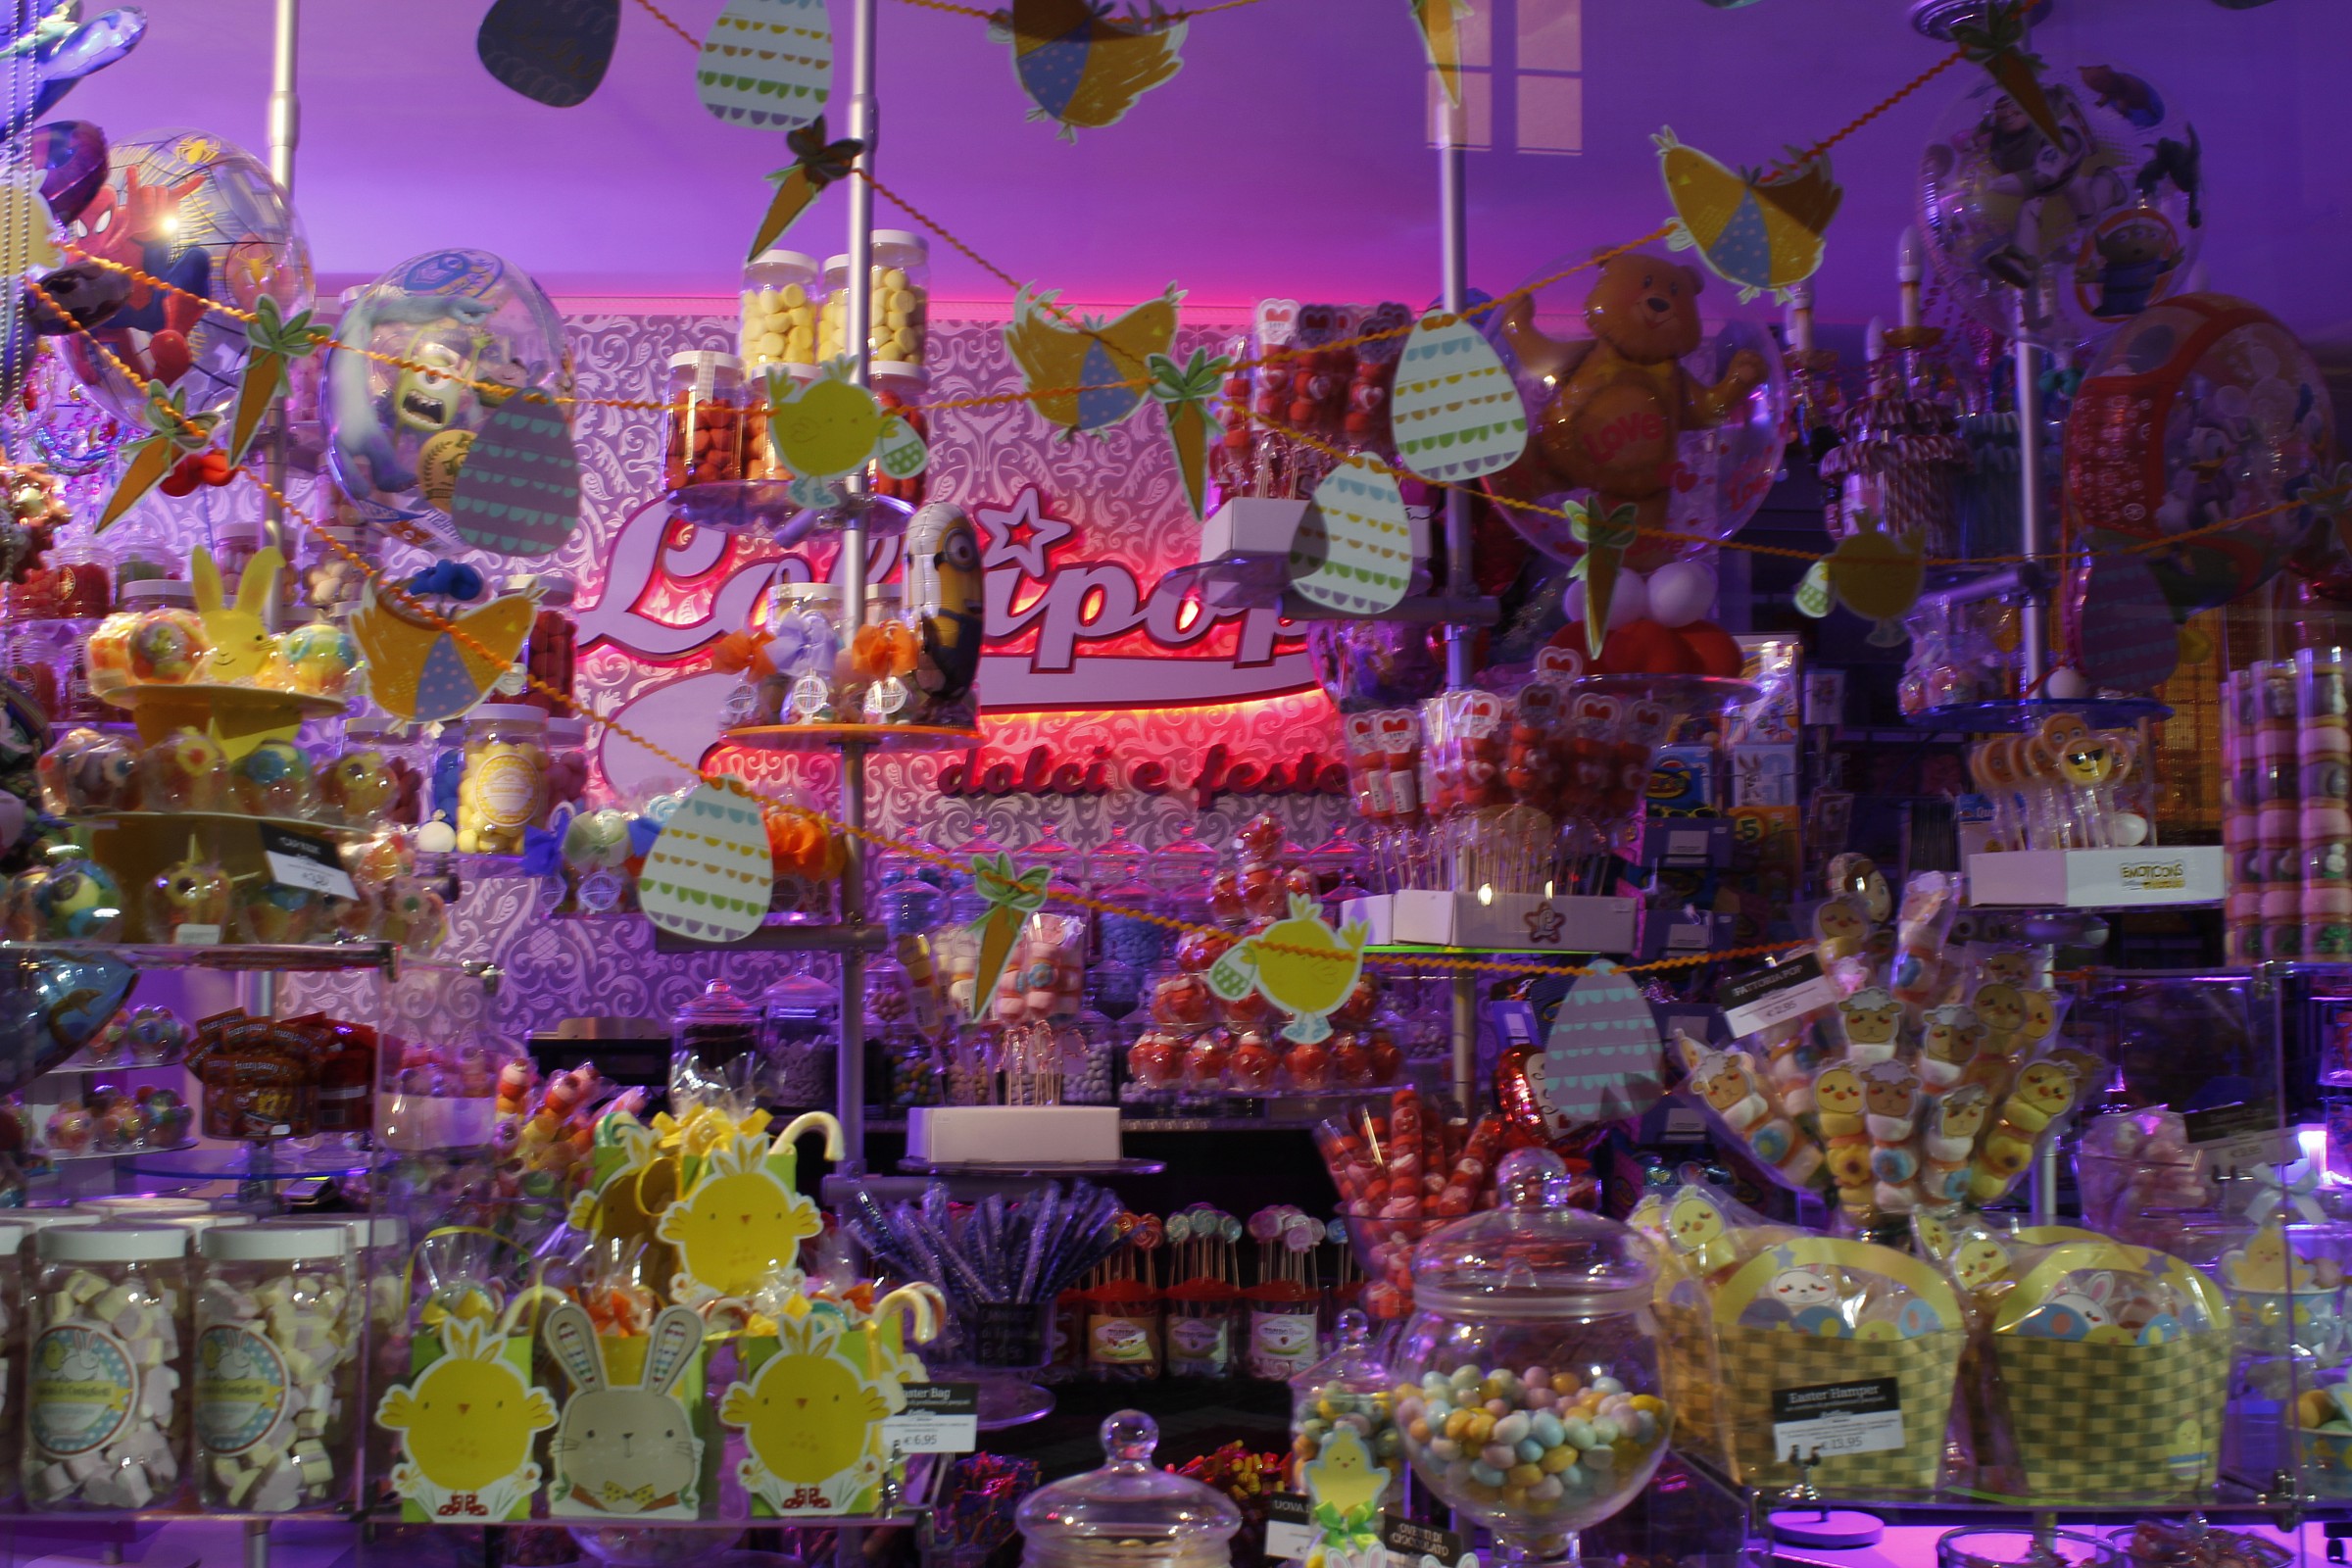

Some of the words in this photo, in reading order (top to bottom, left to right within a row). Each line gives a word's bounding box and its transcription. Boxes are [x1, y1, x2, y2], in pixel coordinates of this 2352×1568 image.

[937, 743, 1113, 796] dolci
[1134, 759, 1170, 794] e
[1193, 741, 1350, 809] feste
[1732, 973, 1785, 998] FATTORIA
[1780, 964, 1804, 983] POP
[931, 1387, 952, 1400] Bag
[1788, 1391, 1829, 1404] Easter
[1830, 1385, 1881, 1400] Hamper
[1273, 1498, 1303, 1512] UOVA
